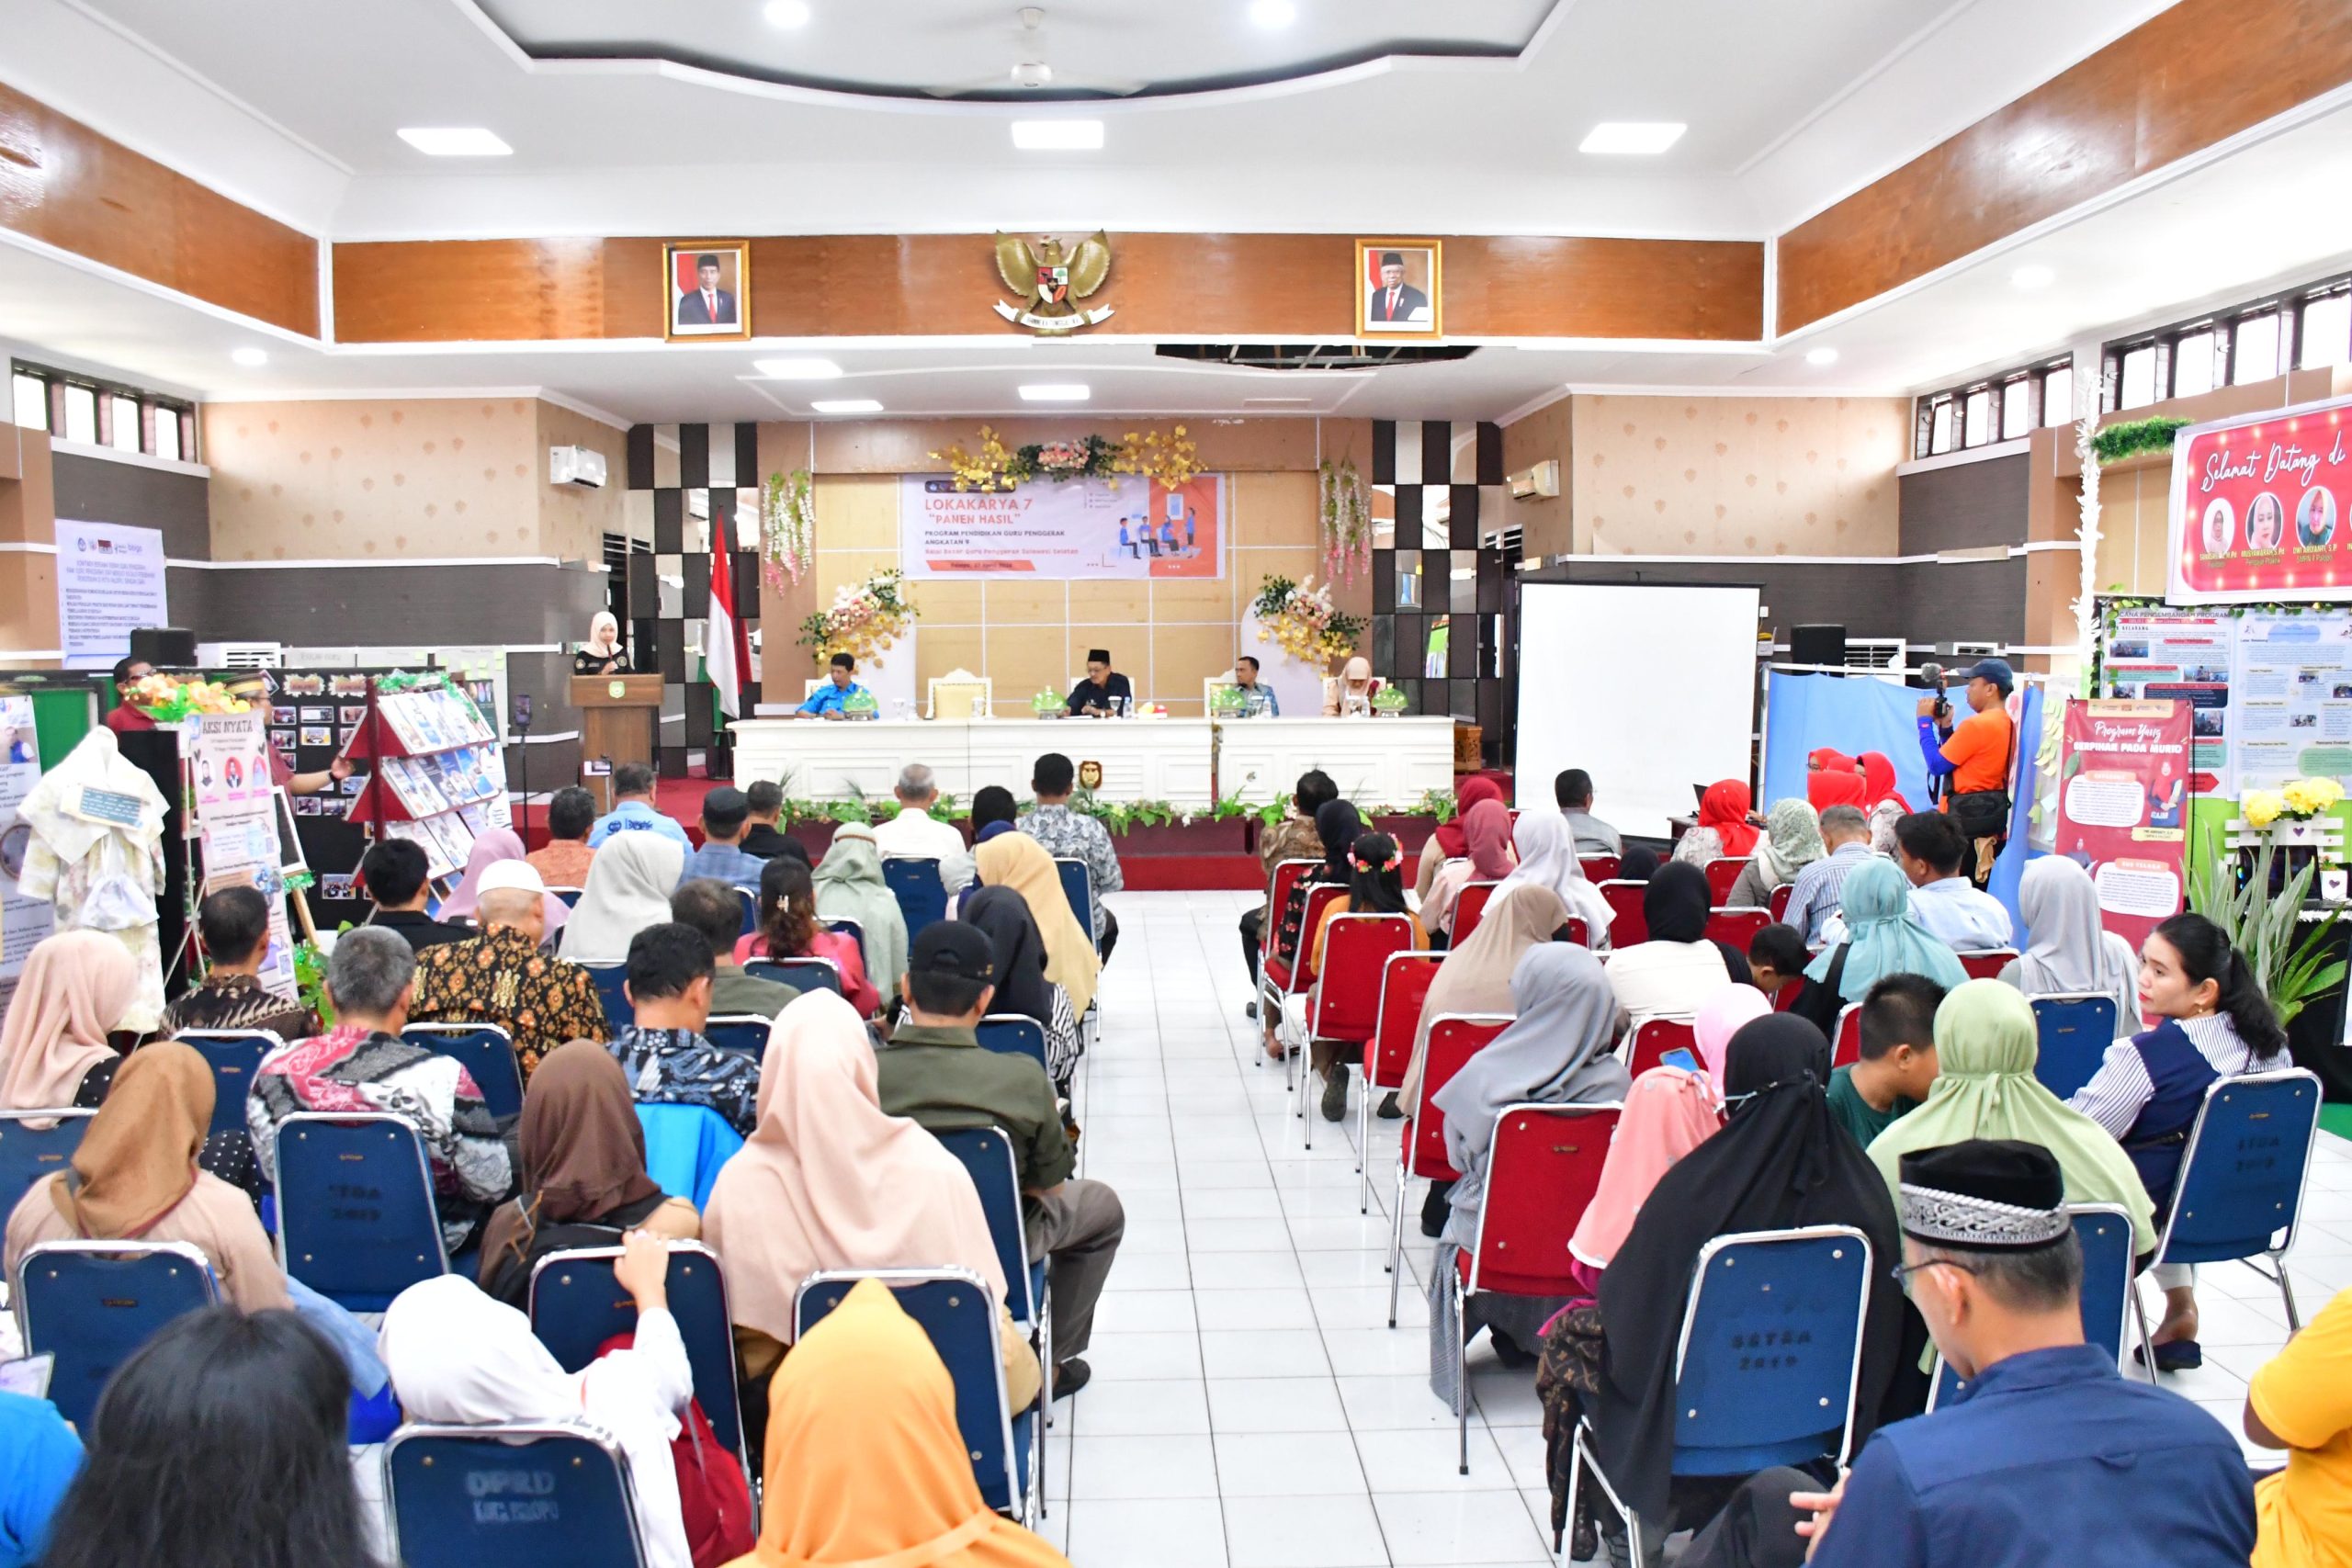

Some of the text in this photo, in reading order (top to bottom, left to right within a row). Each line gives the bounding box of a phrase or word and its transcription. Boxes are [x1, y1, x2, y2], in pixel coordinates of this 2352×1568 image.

[2200, 430, 2346, 492] Selamat Datang di
[925, 499, 1033, 511] LOKAKARYA 7
[202, 720, 254, 734] AKSI NYATA
[2095, 720, 2161, 743] Program Yang
[2074, 742, 2183, 753] BERPIHAK PADA MURID
